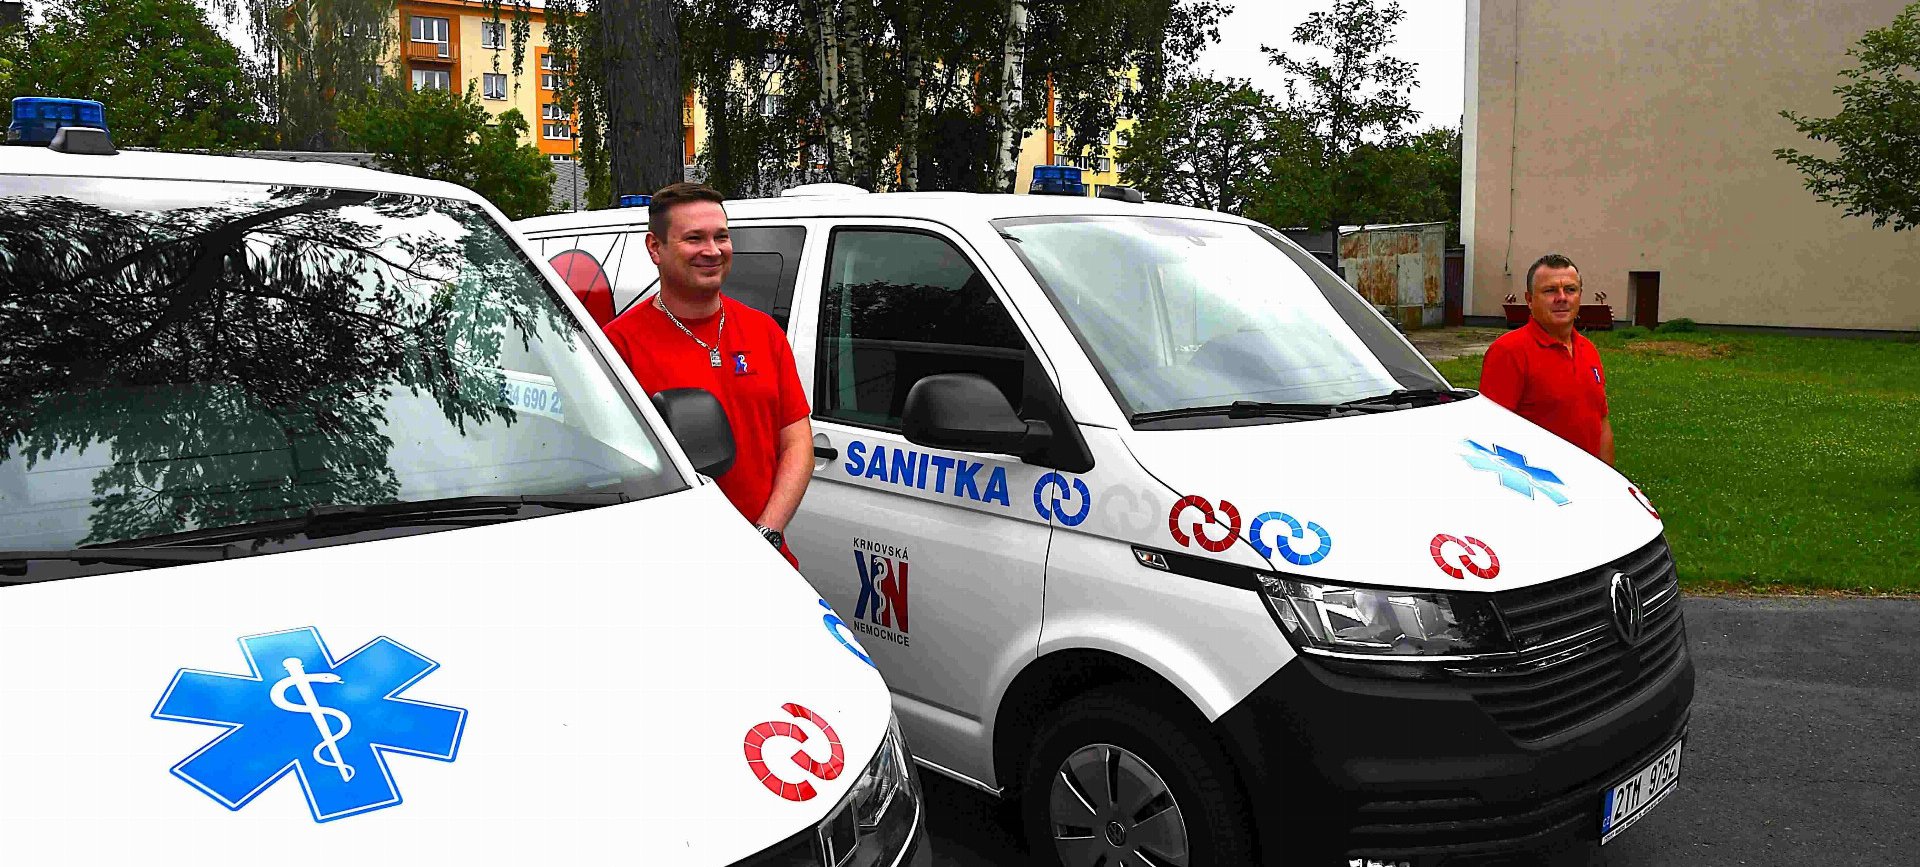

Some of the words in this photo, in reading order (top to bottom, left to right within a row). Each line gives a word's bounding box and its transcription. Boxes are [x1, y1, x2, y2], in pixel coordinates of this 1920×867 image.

[523, 386, 547, 411] 690
[844, 440, 1010, 507] SANITKA
[853, 537, 909, 561] KRNOVSKÁ
[853, 620, 910, 647] NEMOCNICE
[1613, 774, 1642, 821] 2TH
[1648, 748, 1677, 795] 9752
